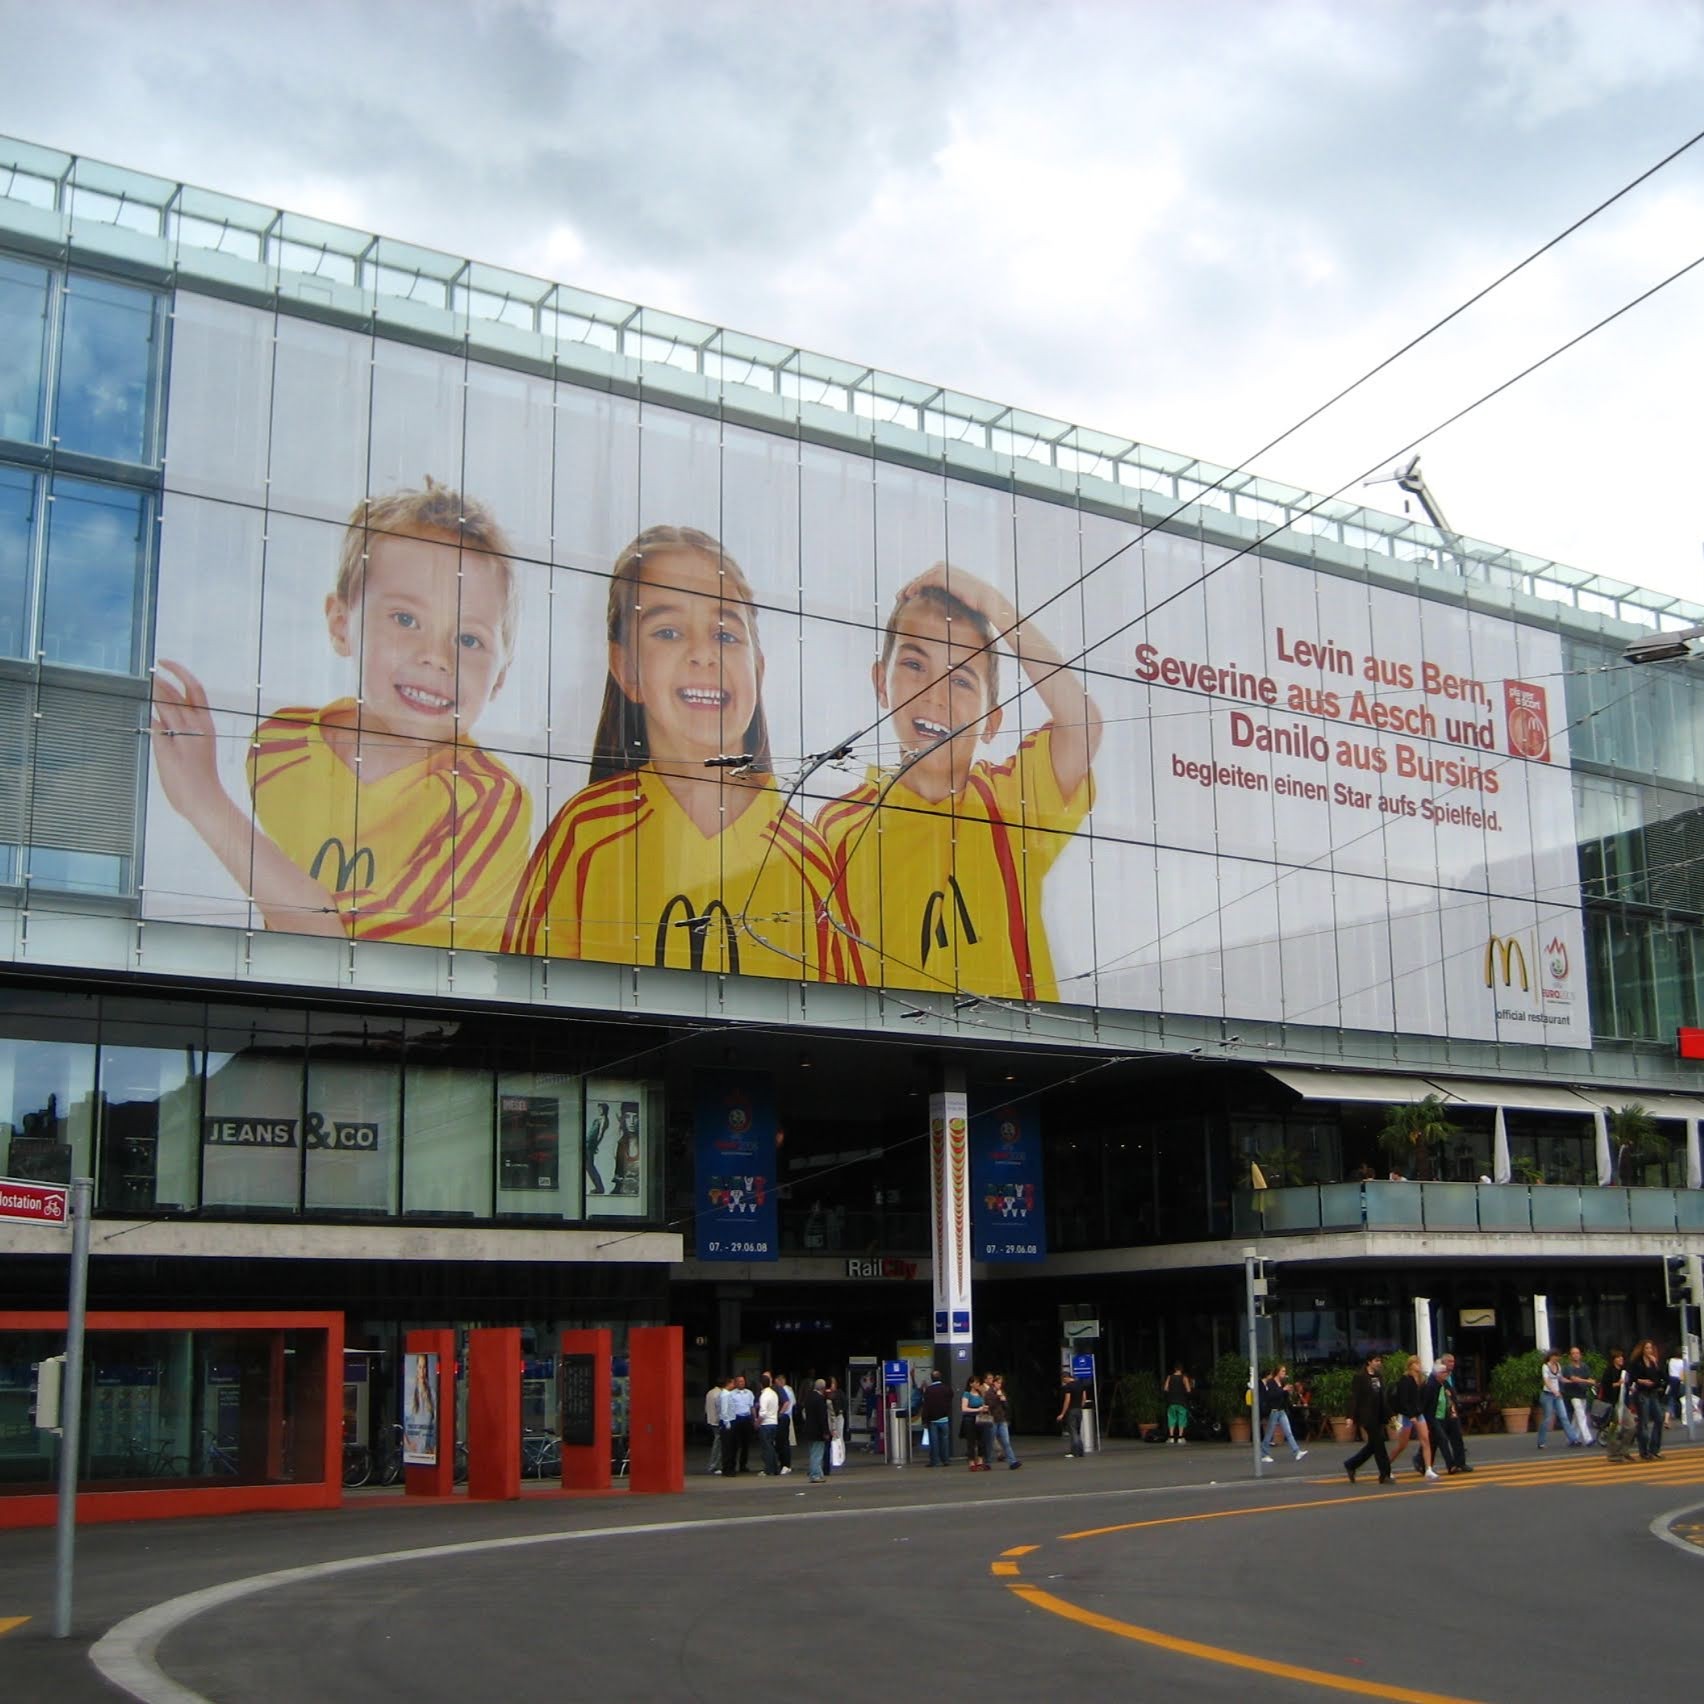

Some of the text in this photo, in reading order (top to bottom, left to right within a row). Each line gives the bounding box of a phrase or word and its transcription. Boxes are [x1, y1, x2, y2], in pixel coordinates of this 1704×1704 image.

[1276, 627, 1493, 712] Levin aus Bern,
[1135, 643, 1495, 750] Severine aus Aesch und
[1515, 698, 1541, 711] escort
[1230, 711, 1499, 794] Danilo aus Bursins
[1172, 753, 1503, 832] begleiten einen Star aufs Spielfeld.
[1496, 1010, 1571, 1026] official restaurant
[210, 1122, 289, 1144] JEANS
[340, 1128, 374, 1147] CO
[731, 1241, 768, 1253] 29.06.08
